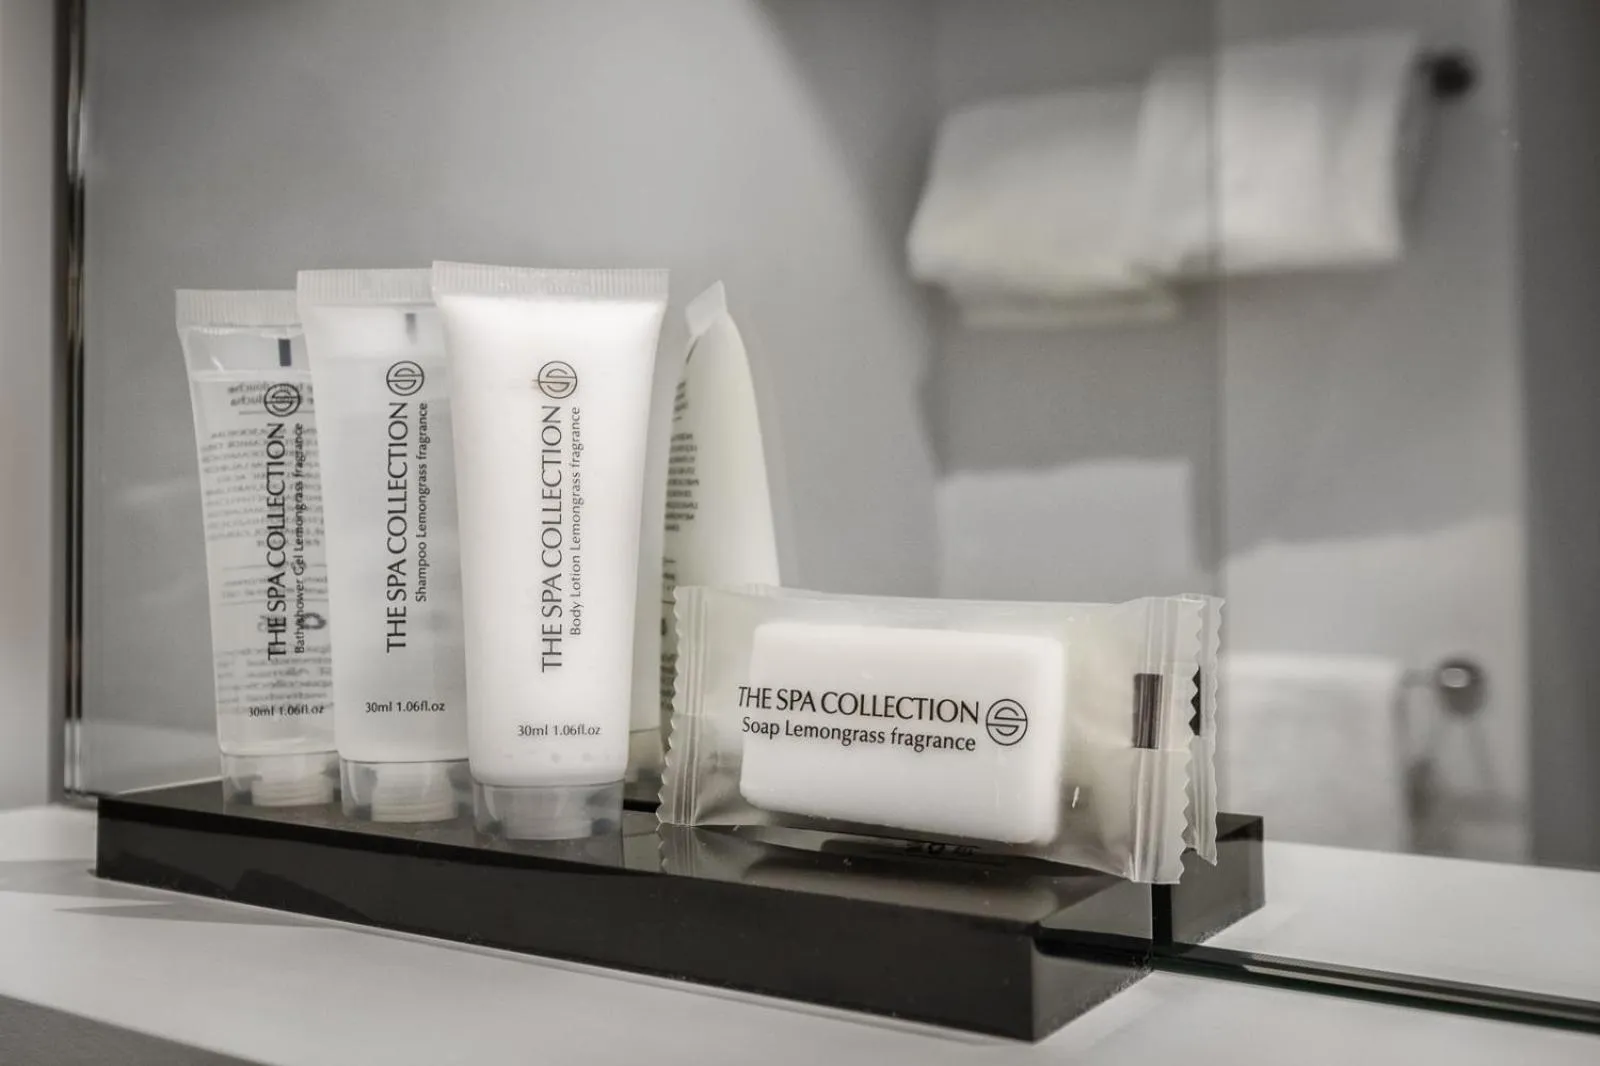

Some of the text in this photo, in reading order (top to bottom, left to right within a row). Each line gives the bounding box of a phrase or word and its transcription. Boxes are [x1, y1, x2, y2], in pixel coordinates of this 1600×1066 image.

[293, 423, 306, 478] fragrance
[293, 481, 307, 552] Lemongrass
[386, 401, 409, 653] THE SPA COLLECTION
[415, 402, 431, 602] Shampoo Lemongrass fragrance
[569, 406, 584, 635] Body Lotion Lemongrass fragrance
[266, 423, 286, 661] THE SPA COLLECTION
[293, 554, 304, 576] Gel
[541, 405, 563, 673] THE SPA COLLECTION
[365, 700, 446, 713] 30ml 1.06fl.oz
[517, 723, 601, 736] 30ml 1.06fl.oz
[738, 686, 980, 725] THE SPA COLLECTION
[741, 716, 977, 753] Soap Lemongrass fragrance
